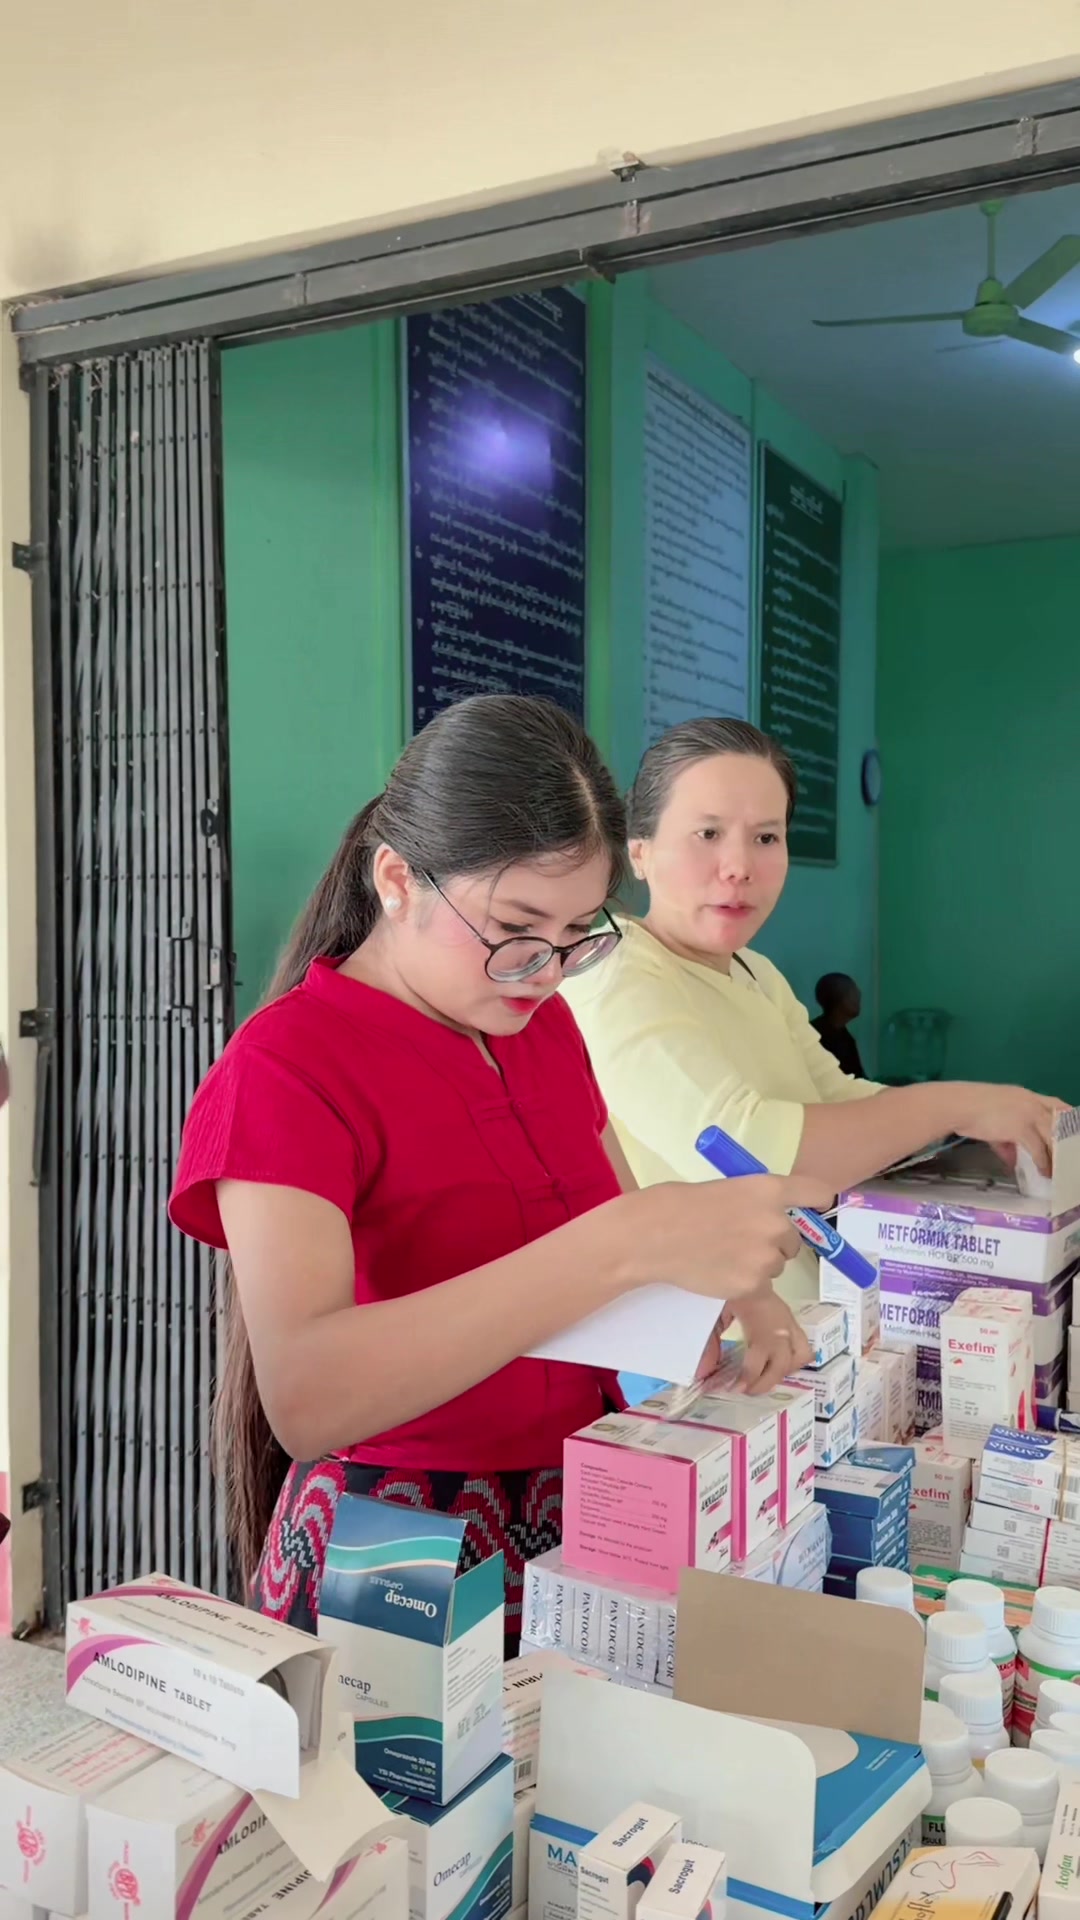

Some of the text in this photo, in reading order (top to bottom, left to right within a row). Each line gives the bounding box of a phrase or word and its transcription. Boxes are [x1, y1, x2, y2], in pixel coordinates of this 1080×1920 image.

[878, 1222, 1001, 1256] METFORMIN TABLET
[948, 1338, 995, 1355] Exefim
[913, 1487, 950, 1501] xefim
[156, 1591, 231, 1622] AMLODIPINE
[234, 1620, 277, 1639] TABLET
[384, 1589, 437, 1618] Omecap
[580, 1592, 591, 1655] PANTOCOR
[607, 1600, 618, 1663] PANTOCOR
[635, 1606, 646, 1671] PANTOCOR
[93, 1651, 212, 1712] AMLODIPINE TABLET
[612, 1817, 648, 1847] Sacrogut
[433, 1852, 471, 1887] Omecap
[547, 1843, 577, 1868] MA
[580, 1866, 609, 1885] Sacrogut
[668, 1859, 695, 1895] Sacrogut
